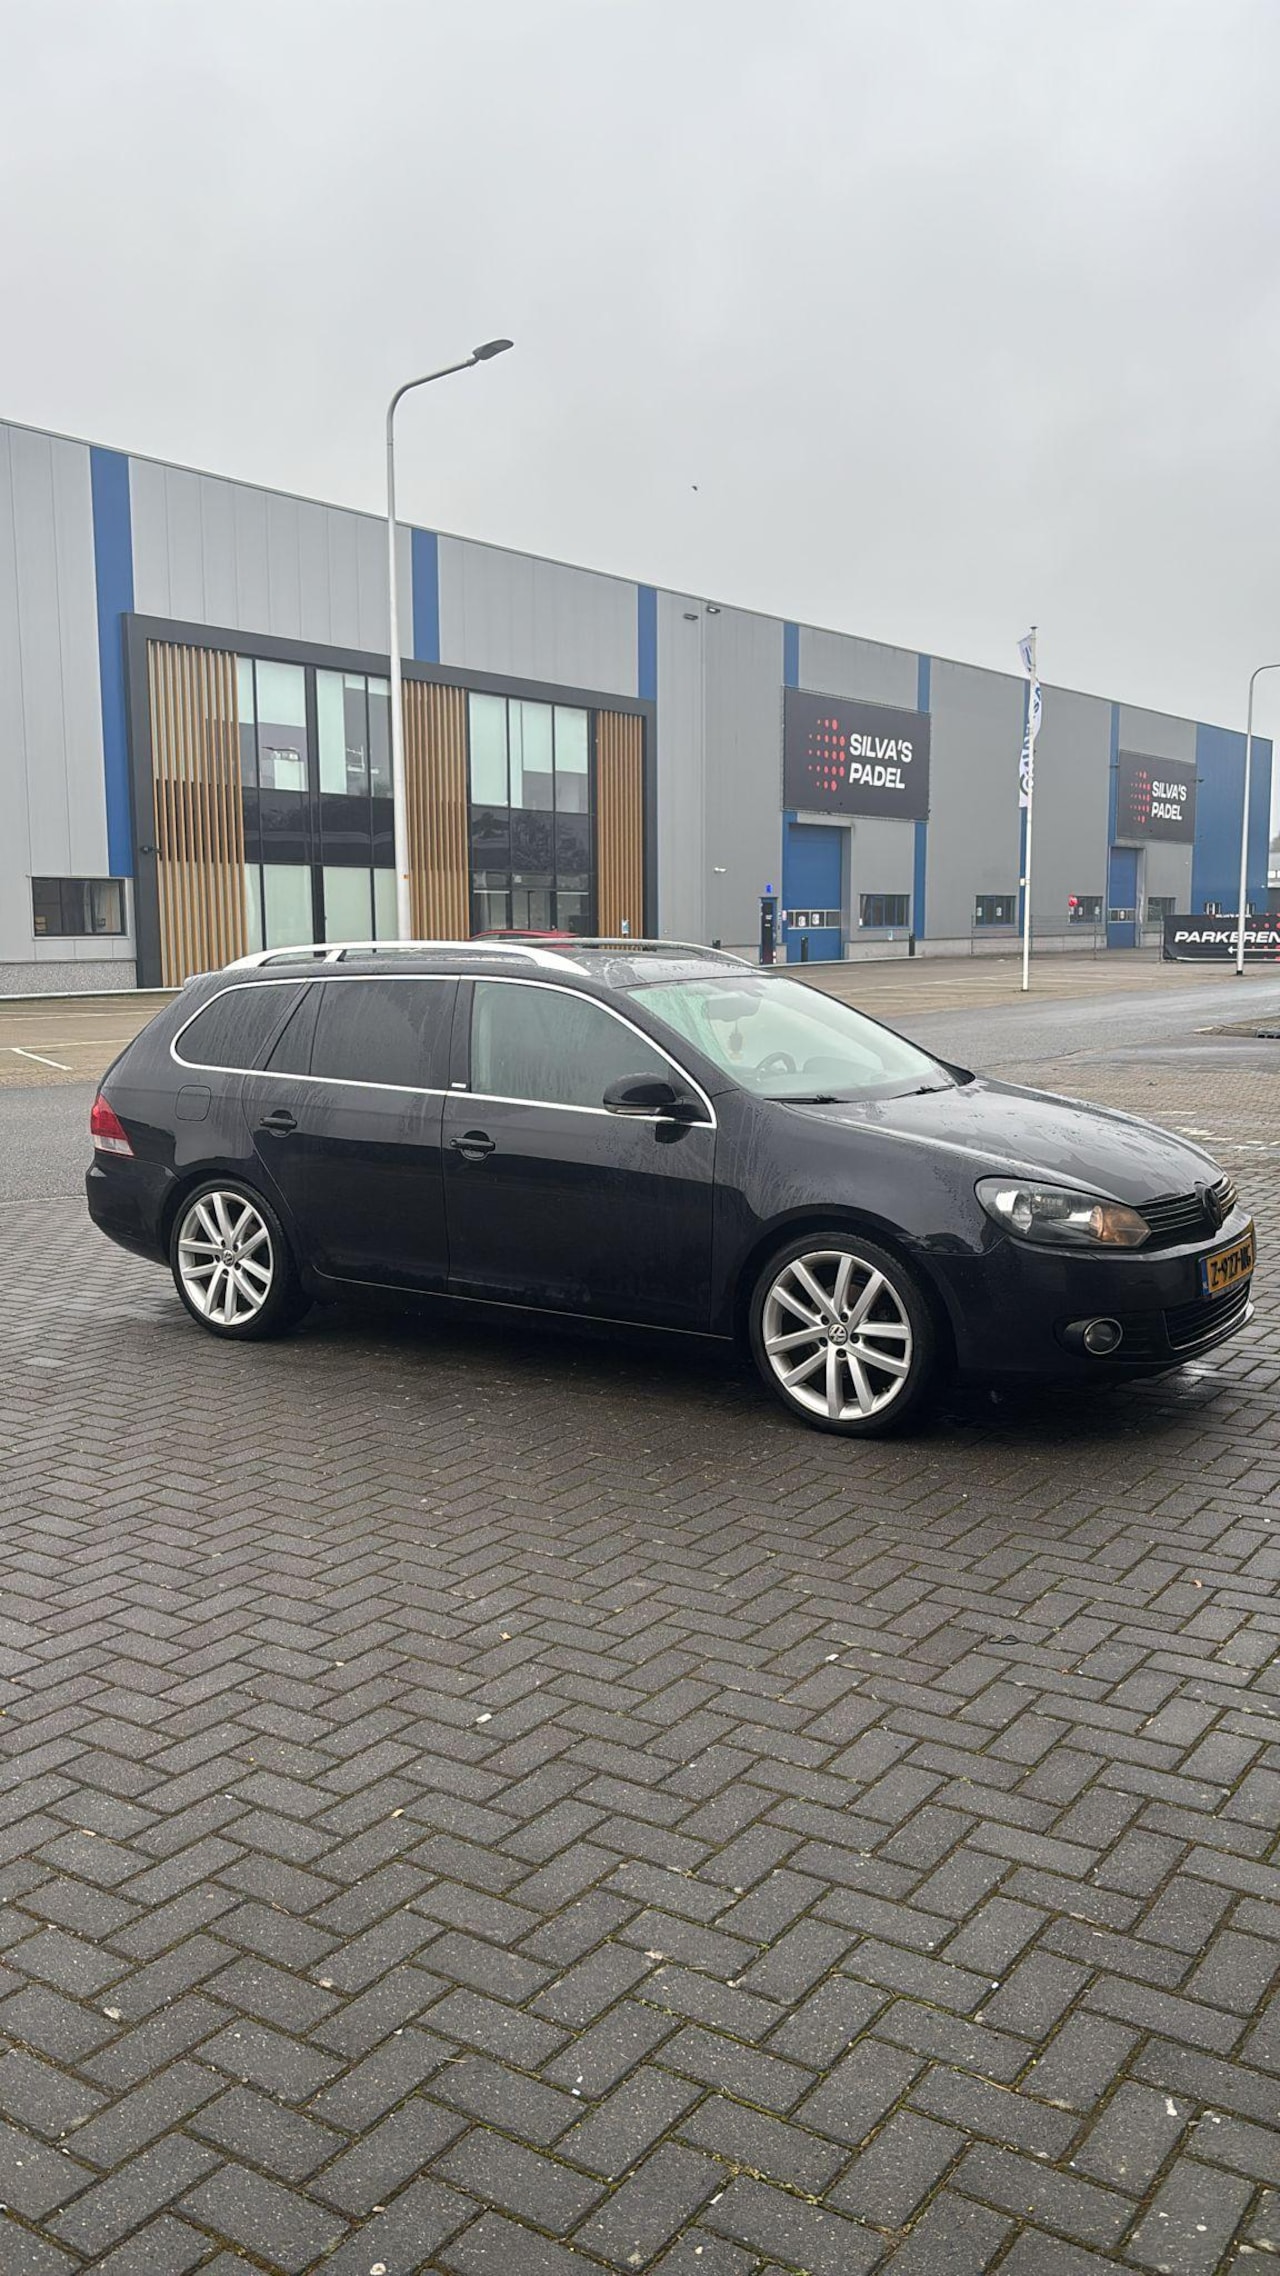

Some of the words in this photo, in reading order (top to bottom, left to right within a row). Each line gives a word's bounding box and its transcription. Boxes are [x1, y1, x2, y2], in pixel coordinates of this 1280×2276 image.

[849, 733, 913, 763] SILVA'S
[849, 762, 906, 789] PADEL
[1151, 781, 1187, 801] SILVA'S
[1151, 802, 1183, 820] PADEL
